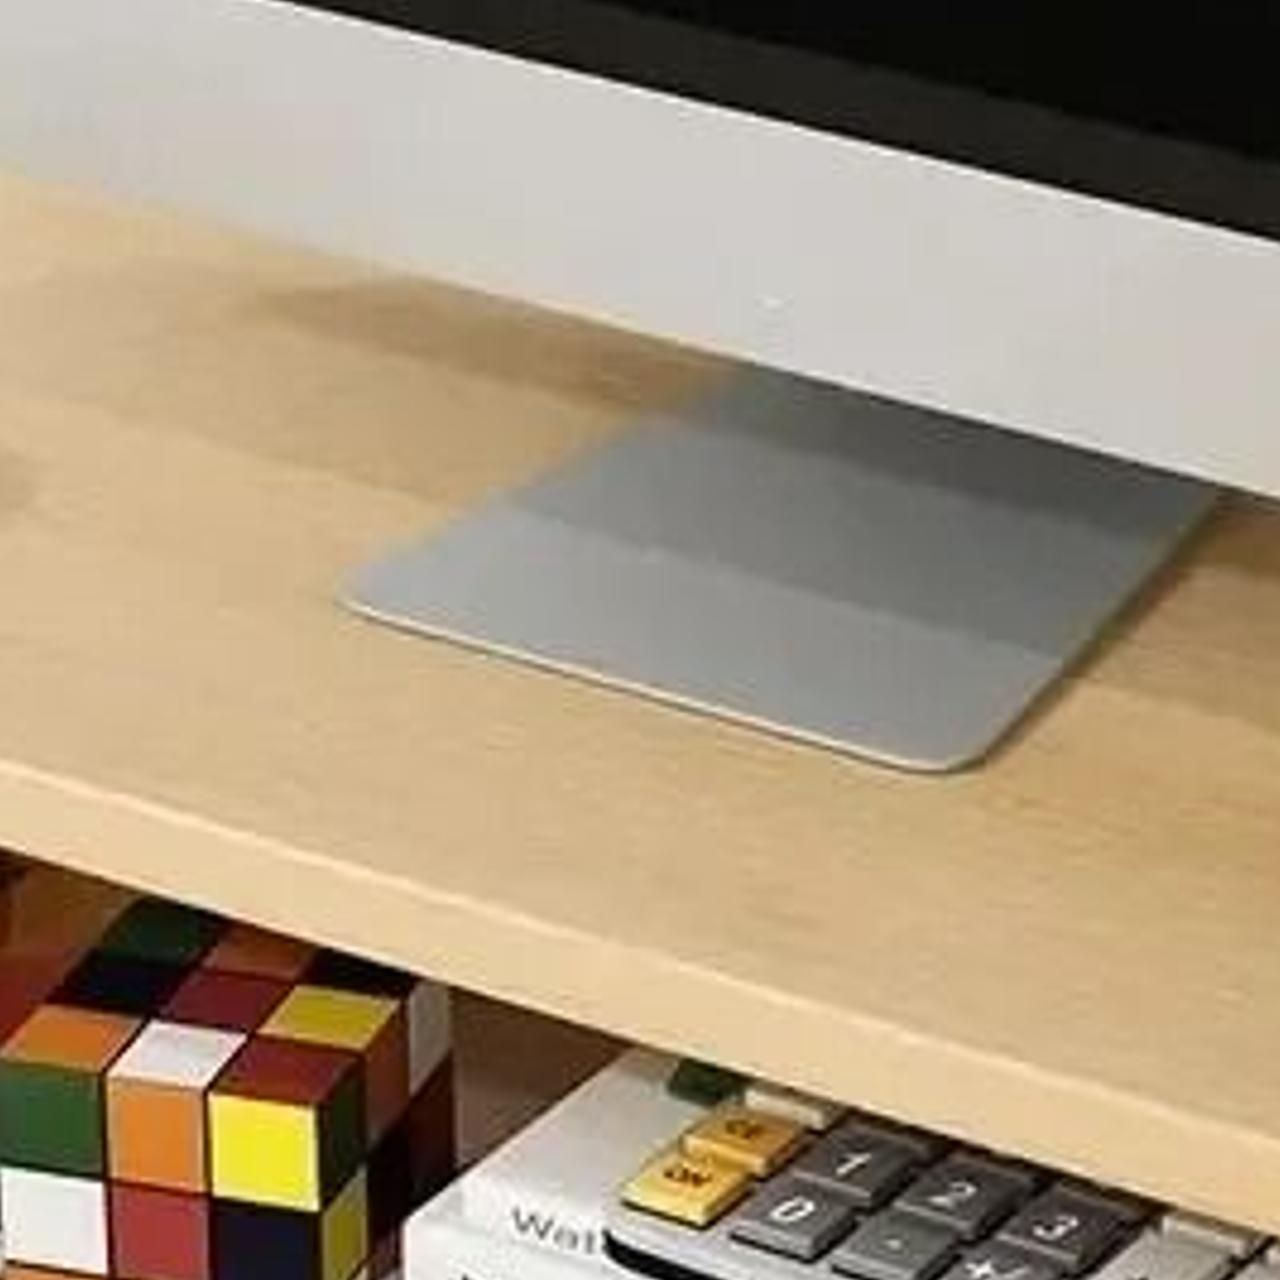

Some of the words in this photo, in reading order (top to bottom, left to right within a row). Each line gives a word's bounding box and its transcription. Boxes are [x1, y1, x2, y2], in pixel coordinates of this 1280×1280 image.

[836, 1150, 872, 1177] 1
[927, 1180, 977, 1207] 2
[770, 1194, 815, 1222] 0
[1032, 1214, 1079, 1240] 3
